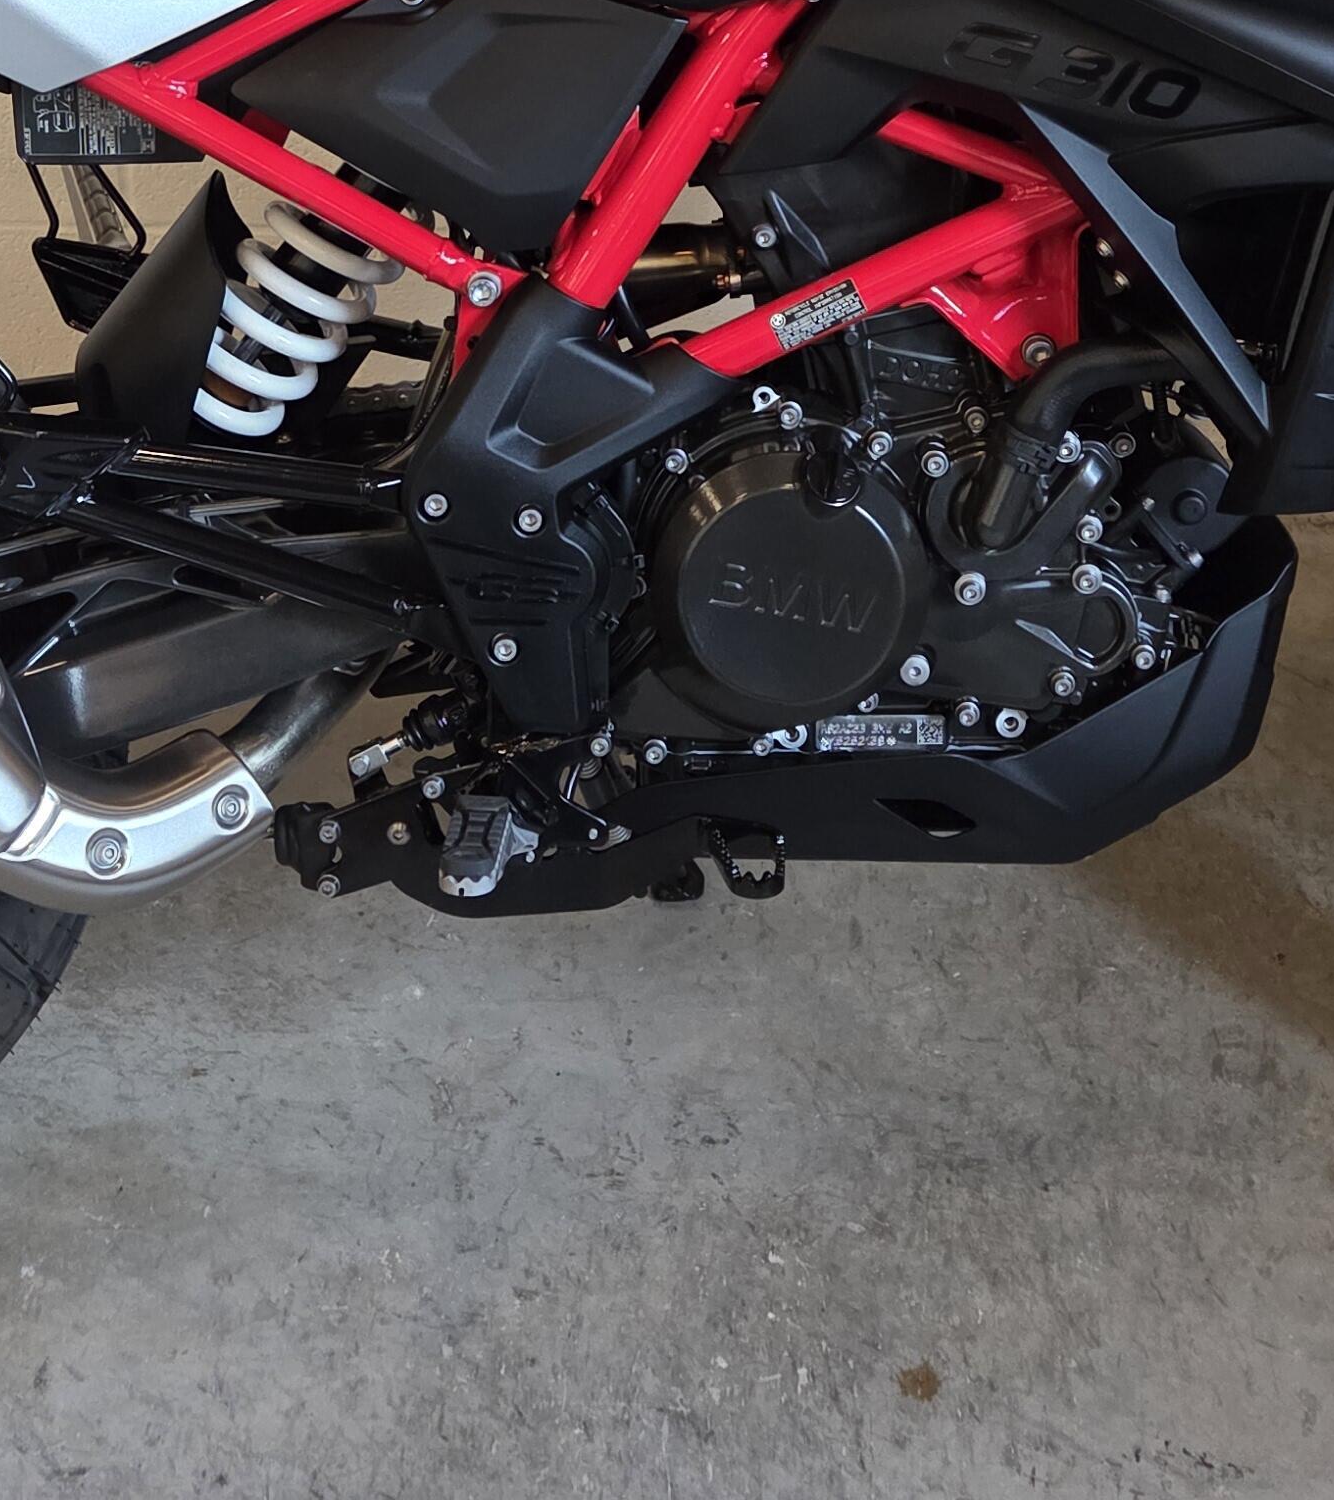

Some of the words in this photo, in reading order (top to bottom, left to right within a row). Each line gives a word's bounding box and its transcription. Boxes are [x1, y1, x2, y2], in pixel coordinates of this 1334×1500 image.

[944, 22, 1042, 82] G
[1033, 45, 1201, 119] 310
[709, 560, 881, 633] BMW
